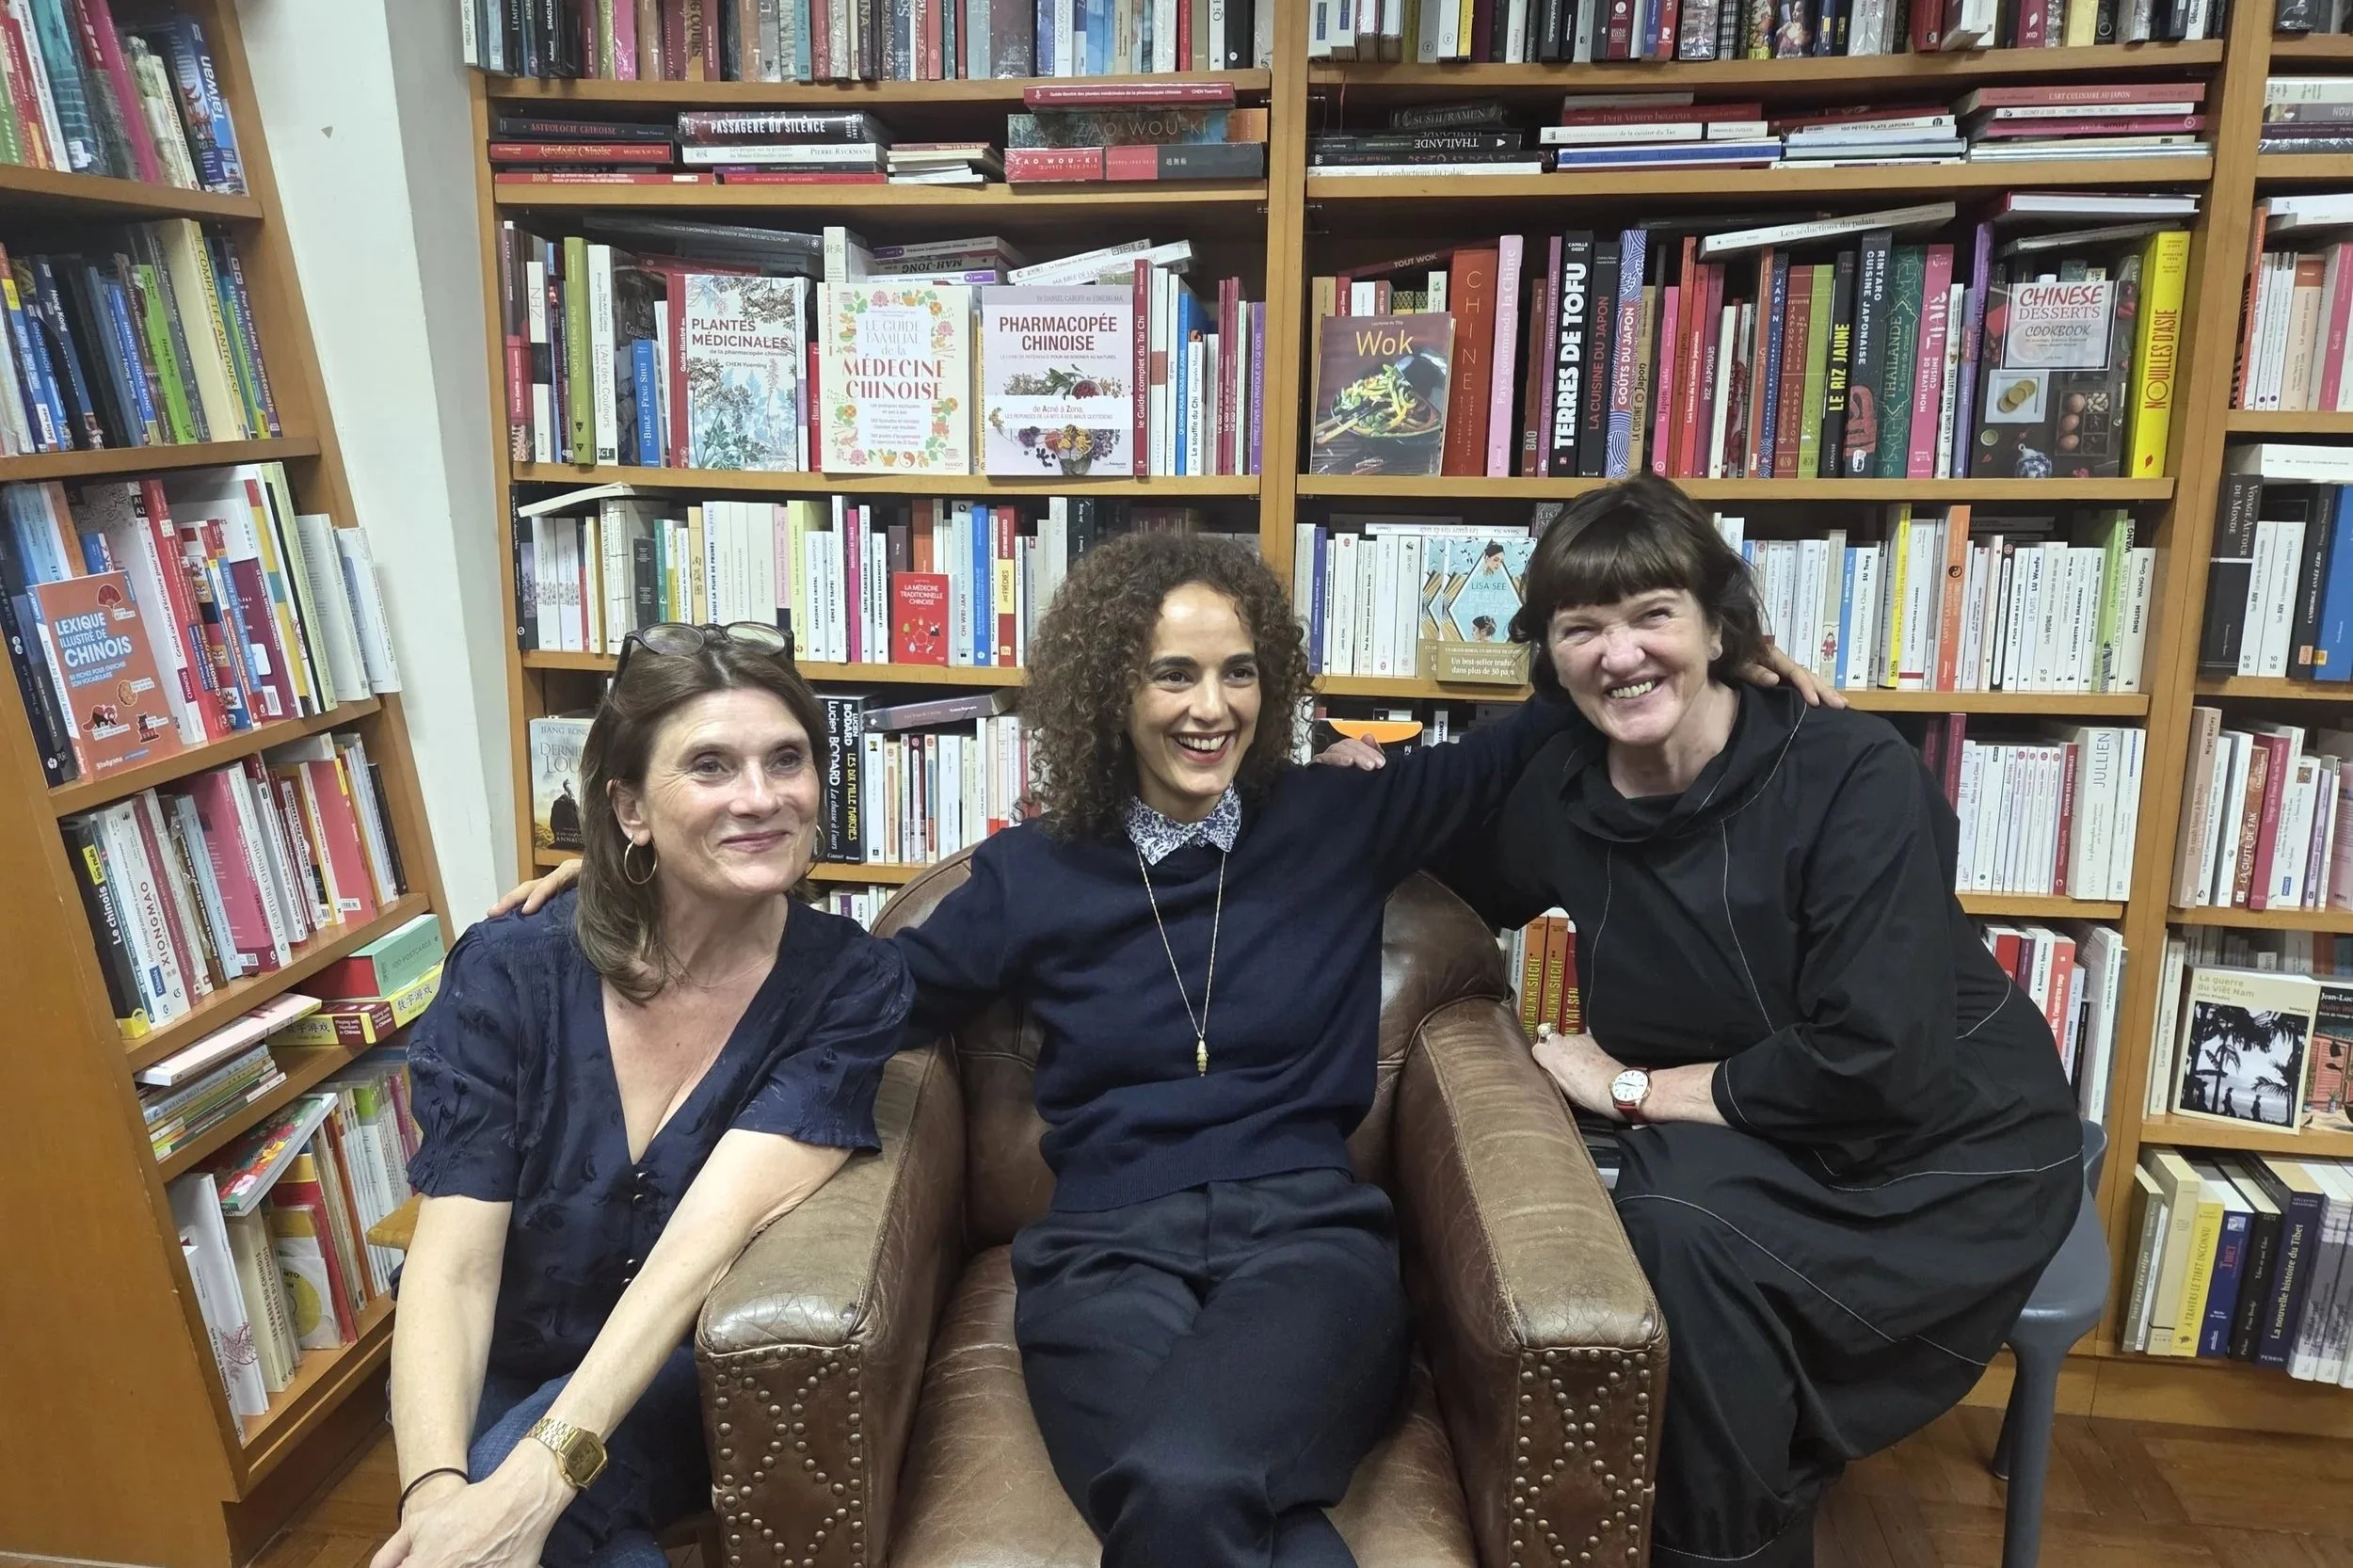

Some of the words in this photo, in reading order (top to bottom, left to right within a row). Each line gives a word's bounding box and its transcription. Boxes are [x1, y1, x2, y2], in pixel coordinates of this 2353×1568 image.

[785, 120, 825, 134] SILENCE
[198, 249, 221, 319] COMPLETE
[1864, 250, 1875, 296] CUISINE
[1874, 250, 1886, 301] RINTARO
[1562, 263, 1587, 327] TOFU
[2019, 285, 2104, 307] CHINESE
[692, 318, 756, 331] PLANTES
[1000, 313, 1117, 332] PHARMACOPÉE
[2018, 306, 2101, 320] DESSERTS
[883, 320, 920, 331] GUIDE
[1622, 307, 1635, 345] JAPON
[1858, 301, 1871, 365] JAPONAISE
[2025, 325, 2092, 337] COOKBOOK
[692, 331, 789, 348] MÉDICINALES
[866, 332, 920, 344] FAMILIAL
[1022, 335, 1095, 351] CHINOISE
[1355, 328, 1414, 357] Wok
[1560, 330, 1582, 362] DE
[1832, 323, 1850, 363] JAUNE
[881, 345, 895, 356] de
[898, 346, 906, 356] la
[1138, 347, 1145, 360] du
[1593, 342, 1606, 360] DU
[1621, 346, 1631, 362] DU
[842, 354, 946, 377] MÉDECINE
[1929, 356, 1940, 390] CUISINE
[846, 379, 942, 400] CHINOISE
[1590, 361, 1605, 411] CUISINE
[1830, 369, 1847, 390] RIZ
[1920, 368, 1929, 392] LIVRE
[1497, 379, 1510, 405] Pays
[1829, 395, 1845, 411] LE
[1919, 393, 1928, 413] MON
[1191, 410, 1198, 420] du
[1554, 366, 1579, 450] TERRES
[1632, 406, 1643, 433] CUISINE
[1589, 413, 1599, 430] LA
[1191, 421, 1199, 447] souffle
[1525, 430, 1538, 451] BAO
[2124, 527, 2135, 553] WANG
[2031, 556, 2041, 581] Wenfu
[2031, 582, 2038, 592] LU
[55, 612, 106, 636] LEXIQUE
[2133, 604, 2141, 633] ENGLISH
[59, 631, 96, 648] ILLUSTRÉ
[97, 629, 108, 640] DE
[64, 635, 133, 667] CHINOIS
[1468, 667, 1481, 676] plus
[827, 701, 840, 734] Lucien
[843, 703, 854, 746] BODARD
[828, 736, 840, 786] BODARD
[847, 753, 857, 768] LES
[2092, 733, 2109, 789] JULLIEN
[847, 769, 856, 781] DIX
[847, 782, 856, 805] MILLE
[100, 885, 118, 928] chinois
[140, 881, 170, 967] XIONGMAO
[110, 929, 122, 945] Le
[2290, 1223, 2304, 1245] Tibet
[2286, 1246, 2297, 1259] du
[2280, 1260, 2296, 1291] histoire
[2272, 1293, 2290, 1328] nouvelle
[2270, 1329, 2281, 1340] La
